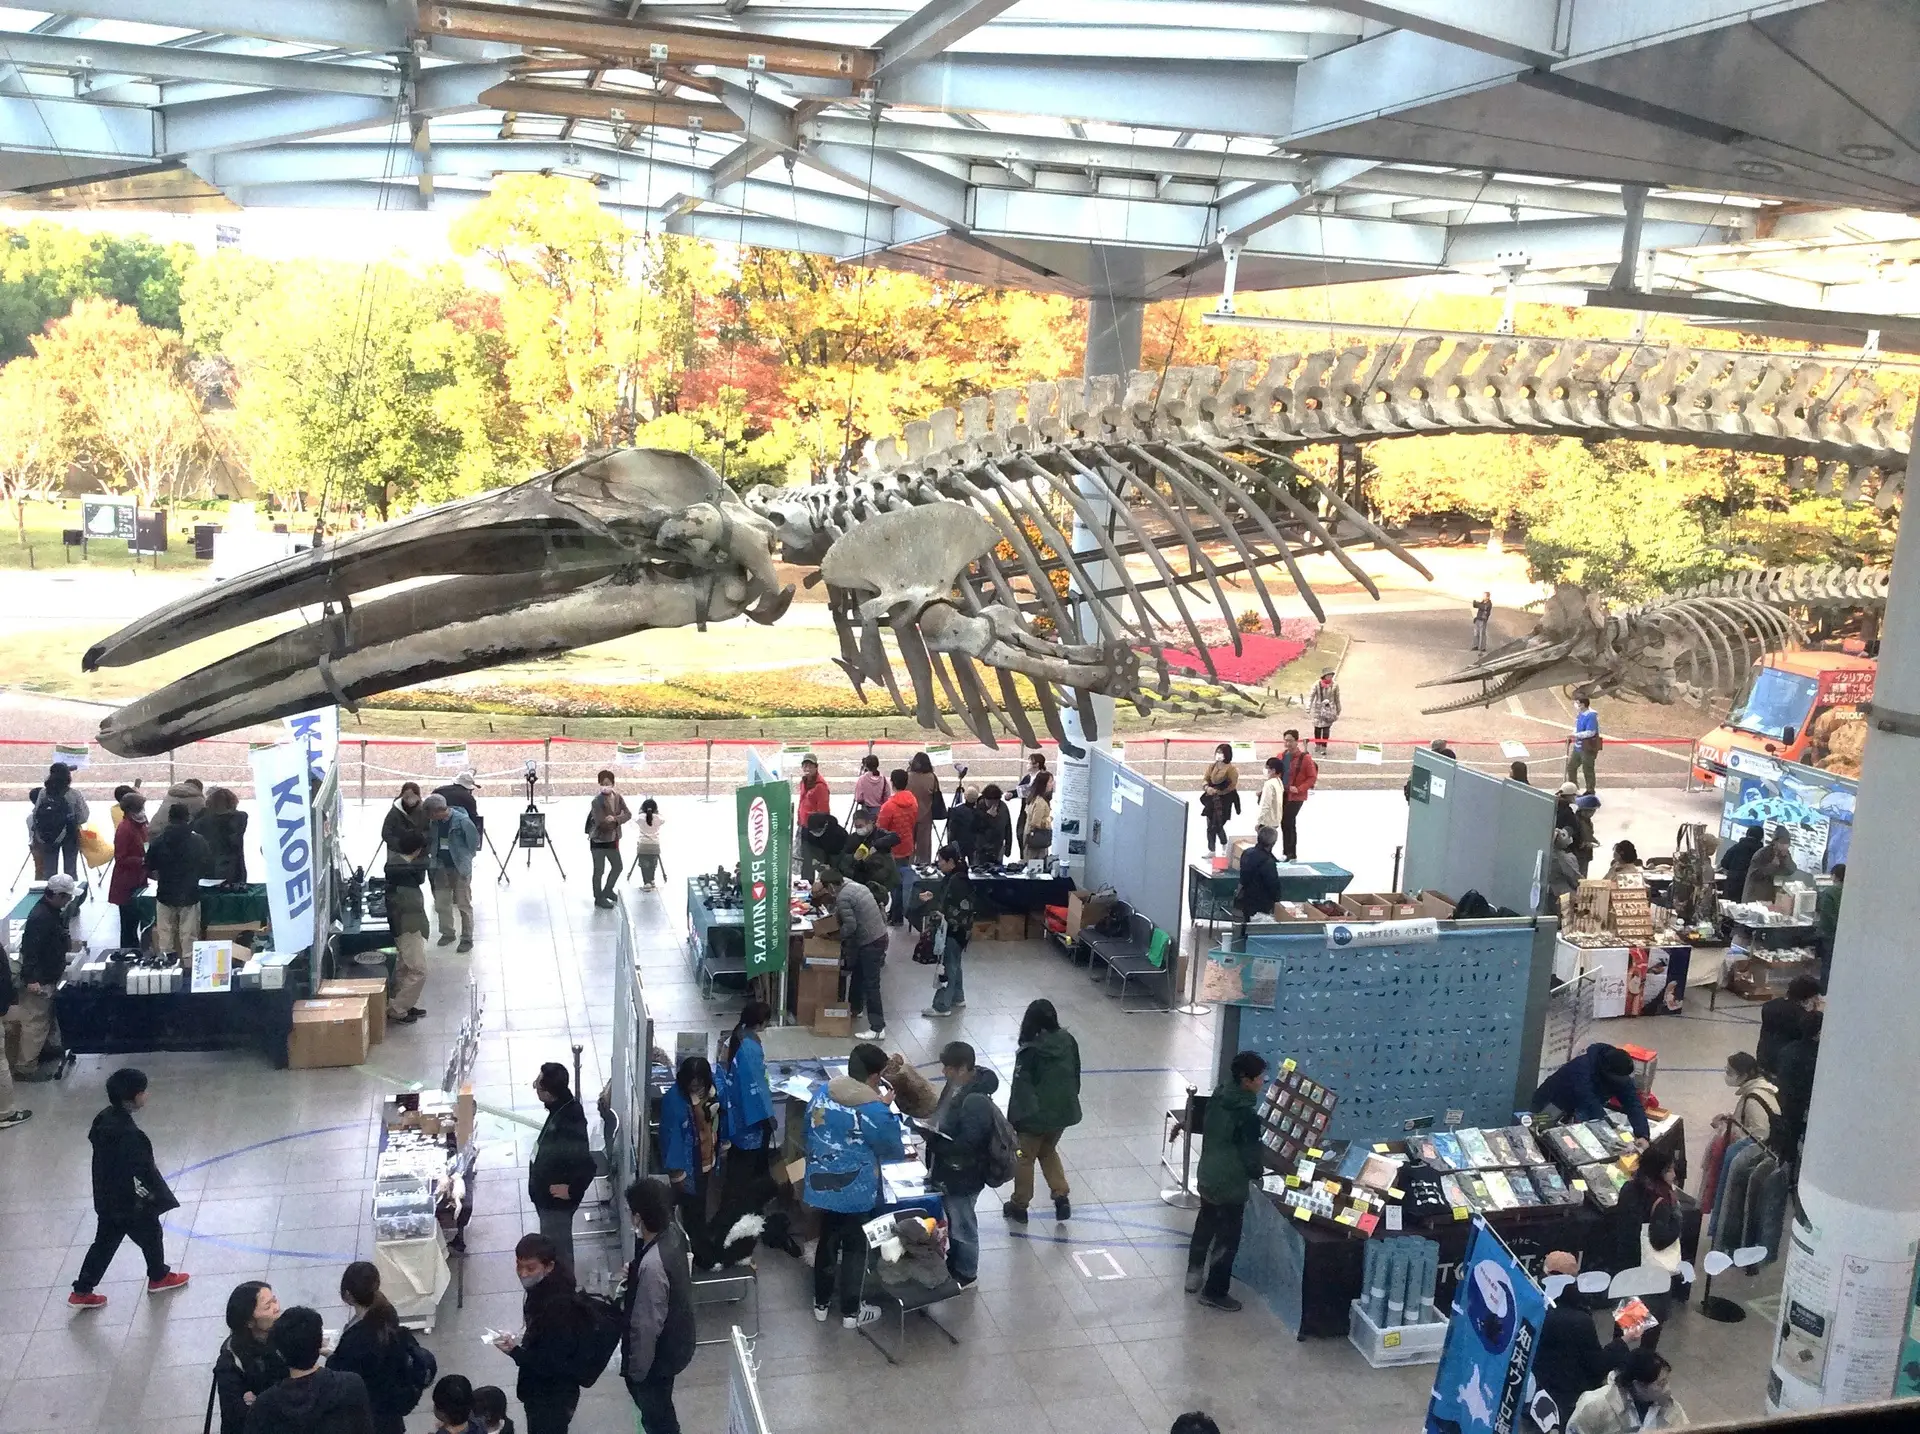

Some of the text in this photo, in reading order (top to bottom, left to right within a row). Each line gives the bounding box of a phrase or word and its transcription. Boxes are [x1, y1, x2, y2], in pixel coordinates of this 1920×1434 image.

[1835, 672, 1872, 682] イタリアの
[1698, 744, 1720, 763] PIZZA
